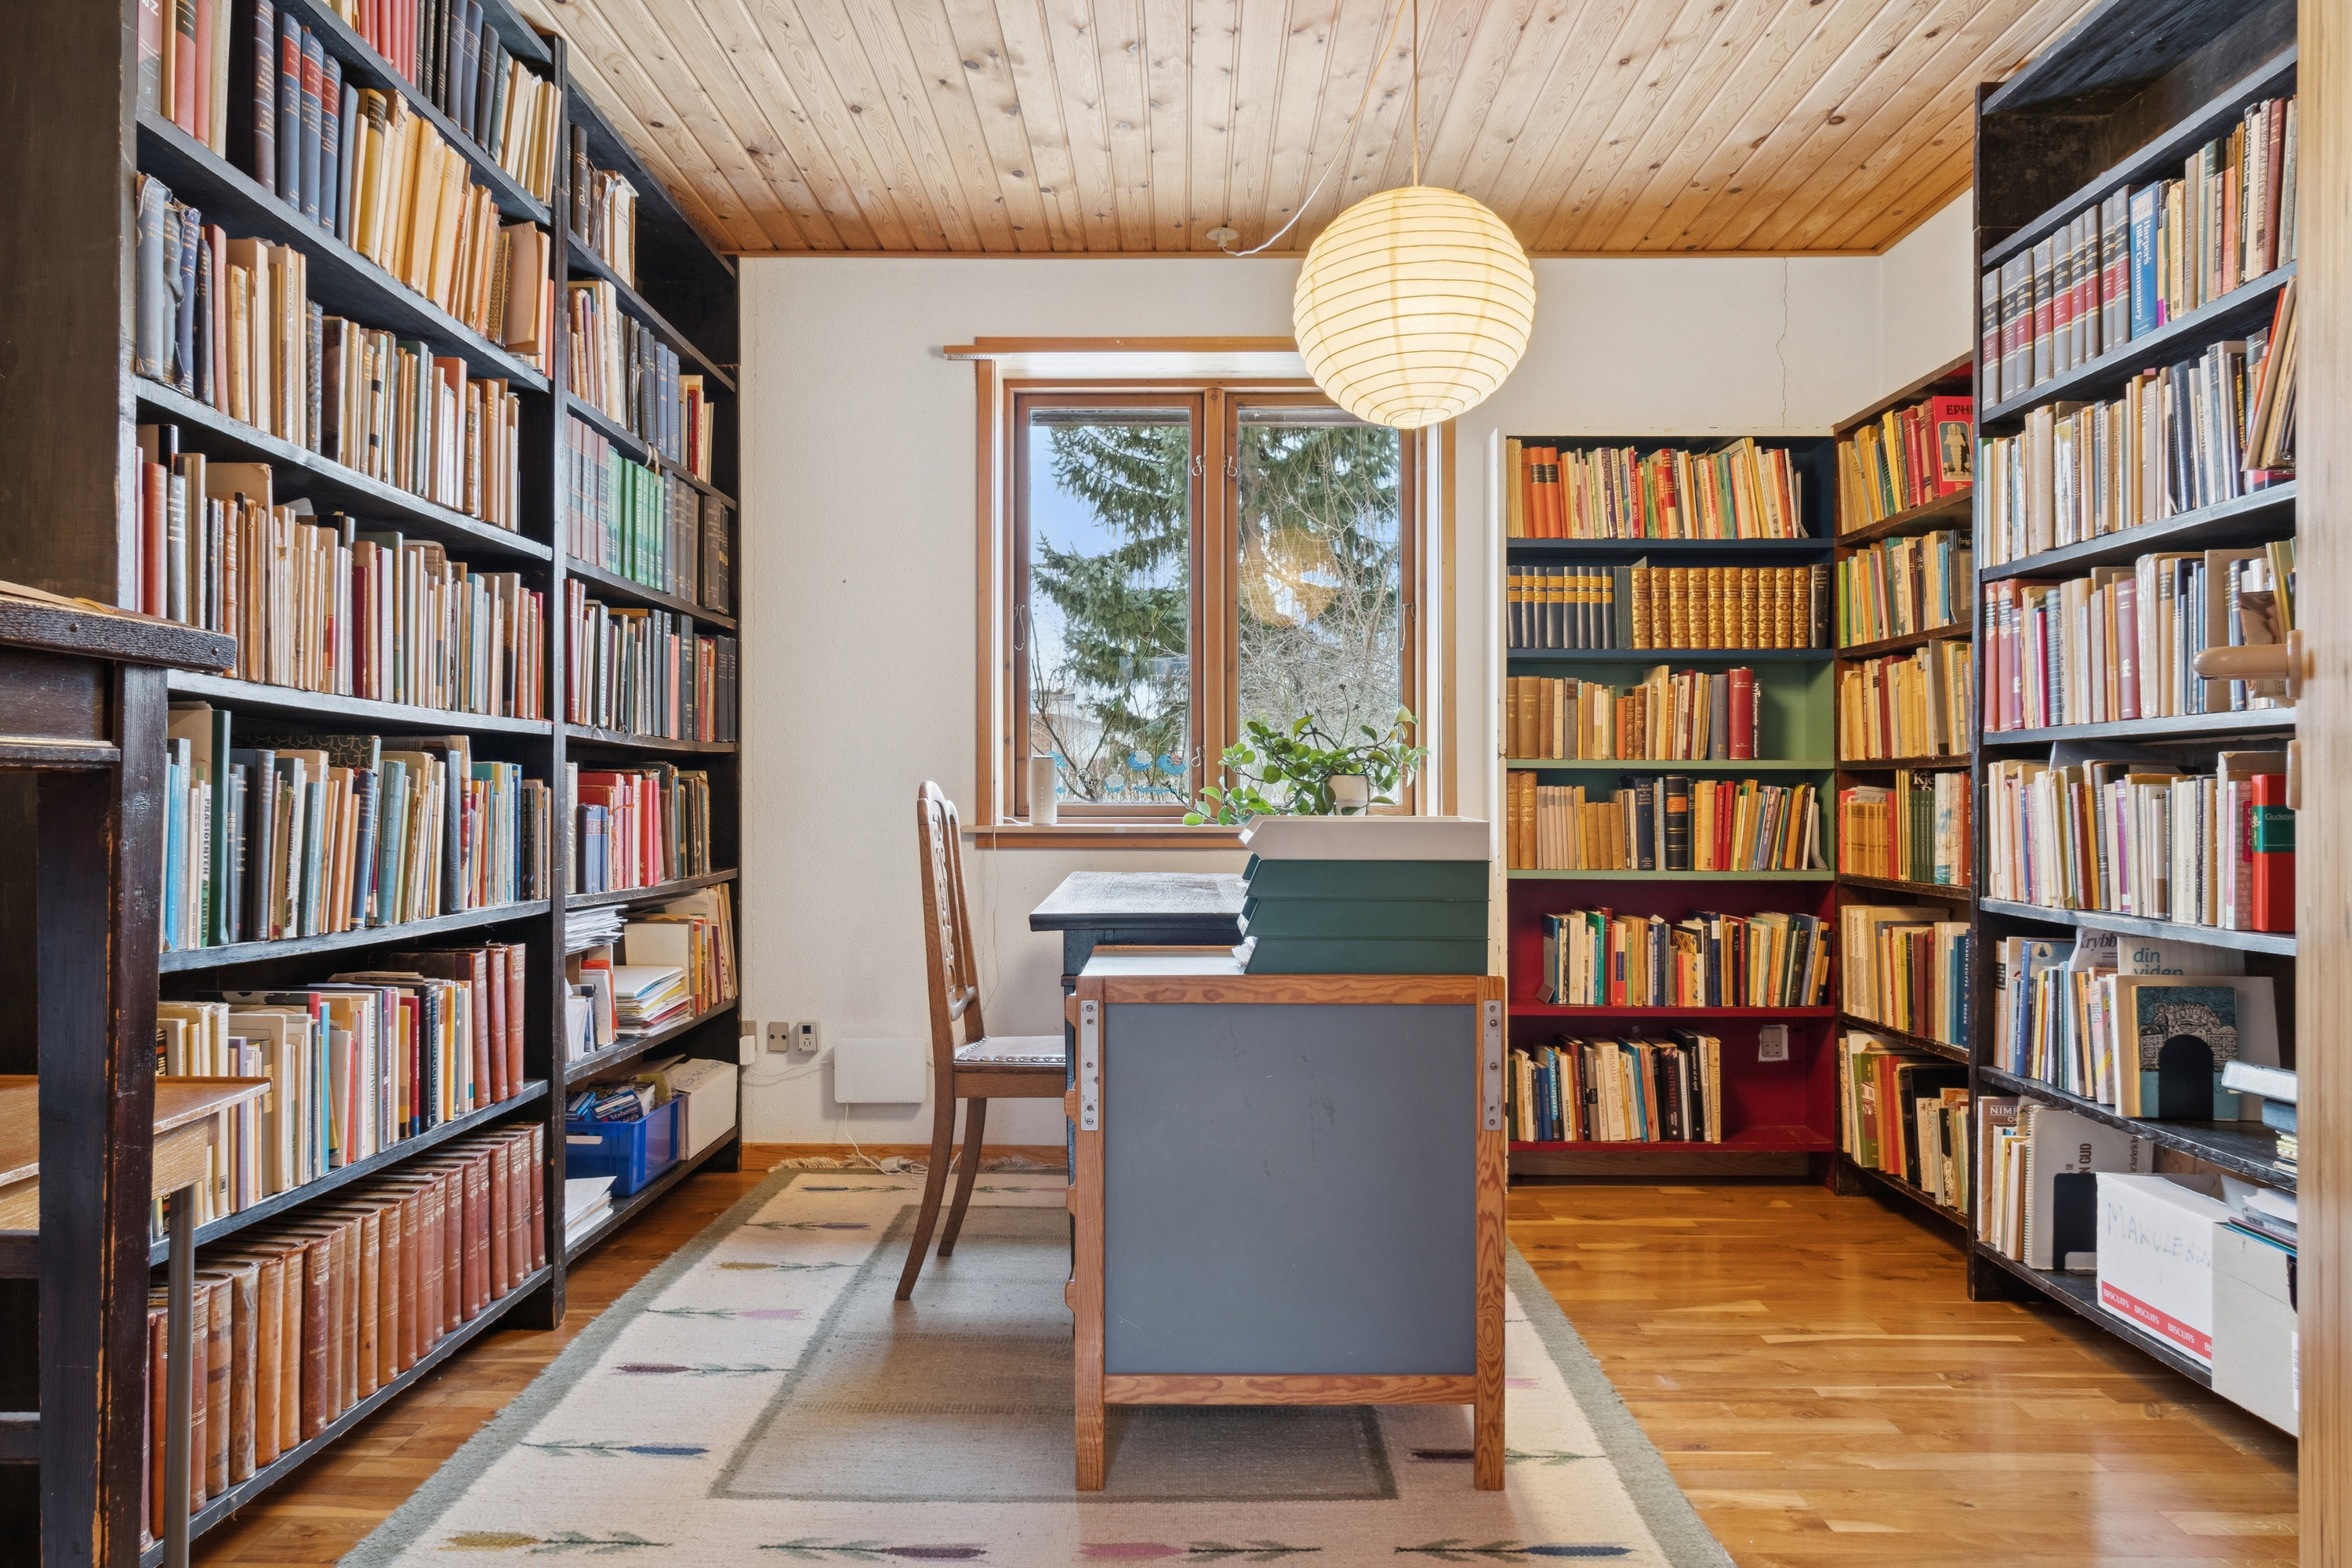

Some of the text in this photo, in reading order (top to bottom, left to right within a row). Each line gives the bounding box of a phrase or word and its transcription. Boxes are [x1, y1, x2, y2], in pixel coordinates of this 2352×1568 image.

[2135, 251, 2143, 320] Commentary
[202, 879, 209, 895] AF
[2133, 948, 2161, 963] din
[610, 1105, 638, 1120] Verbatim
[2079, 1143, 2091, 1164] GUD
[2103, 1288, 2130, 1308] BISCUITS
[2134, 1305, 2159, 1325] BISCUITS
[2168, 1323, 2195, 1344] BISCUITS
